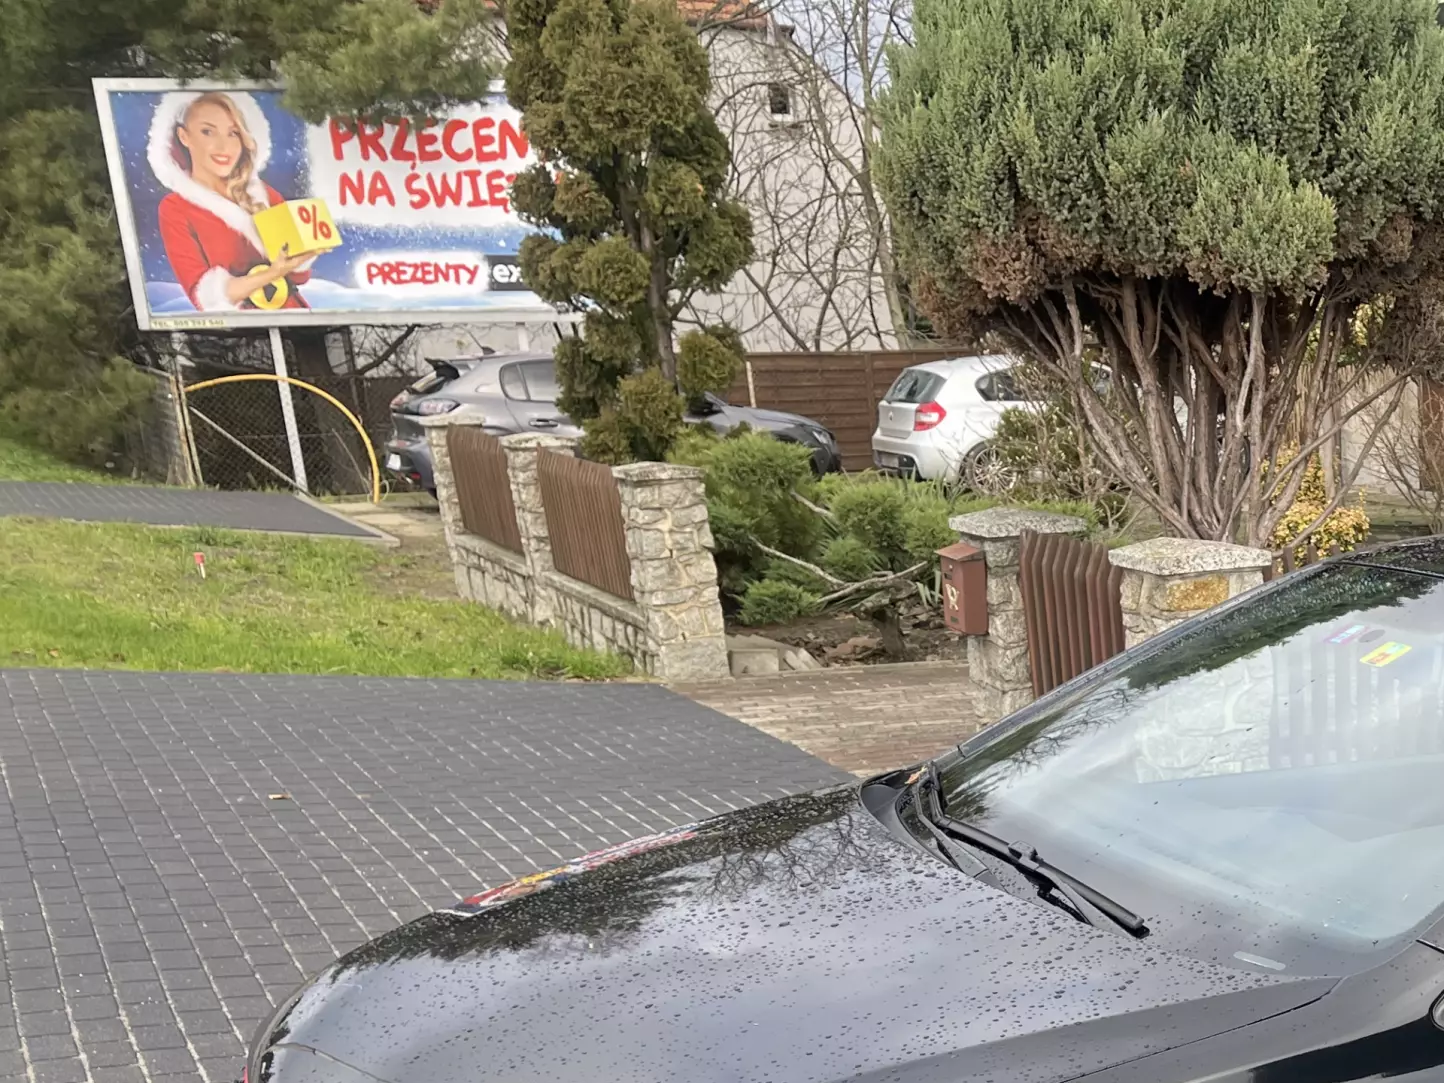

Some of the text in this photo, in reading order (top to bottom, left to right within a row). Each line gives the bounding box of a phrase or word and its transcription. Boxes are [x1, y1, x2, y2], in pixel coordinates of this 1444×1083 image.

[329, 116, 529, 163] PRZECEN
[339, 162, 517, 213] NA ŚWIĘ
[297, 204, 332, 240] %
[366, 261, 479, 285] PREZENTY
[493, 263, 524, 283] ex
